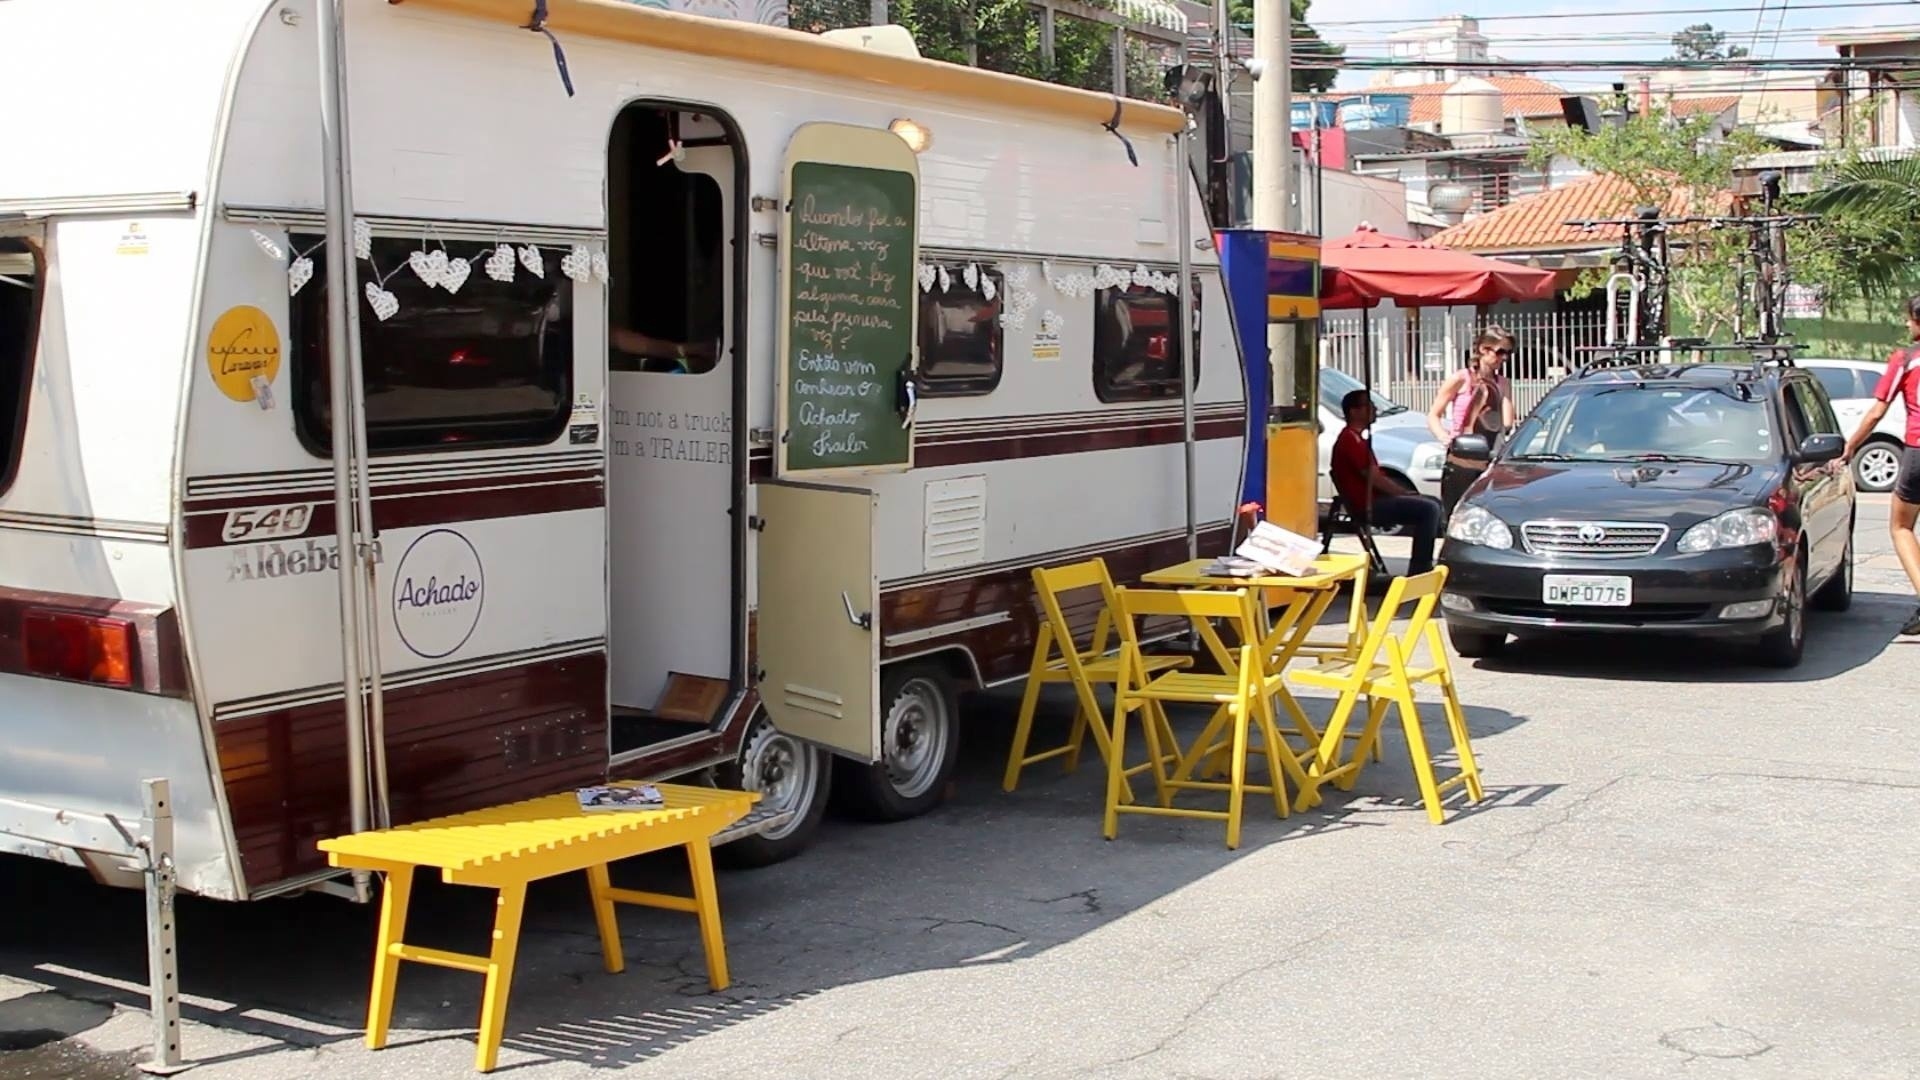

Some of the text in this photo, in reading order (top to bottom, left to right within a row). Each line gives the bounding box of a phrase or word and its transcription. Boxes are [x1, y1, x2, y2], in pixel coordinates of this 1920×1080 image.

[798, 348, 840, 372] Então
[636, 411, 663, 428] not
[668, 413, 679, 430] a
[799, 401, 861, 426] Achado
[635, 441, 645, 457] a
[650, 436, 732, 465] TRAILER
[229, 504, 309, 539] 540
[398, 575, 480, 611] Achado
